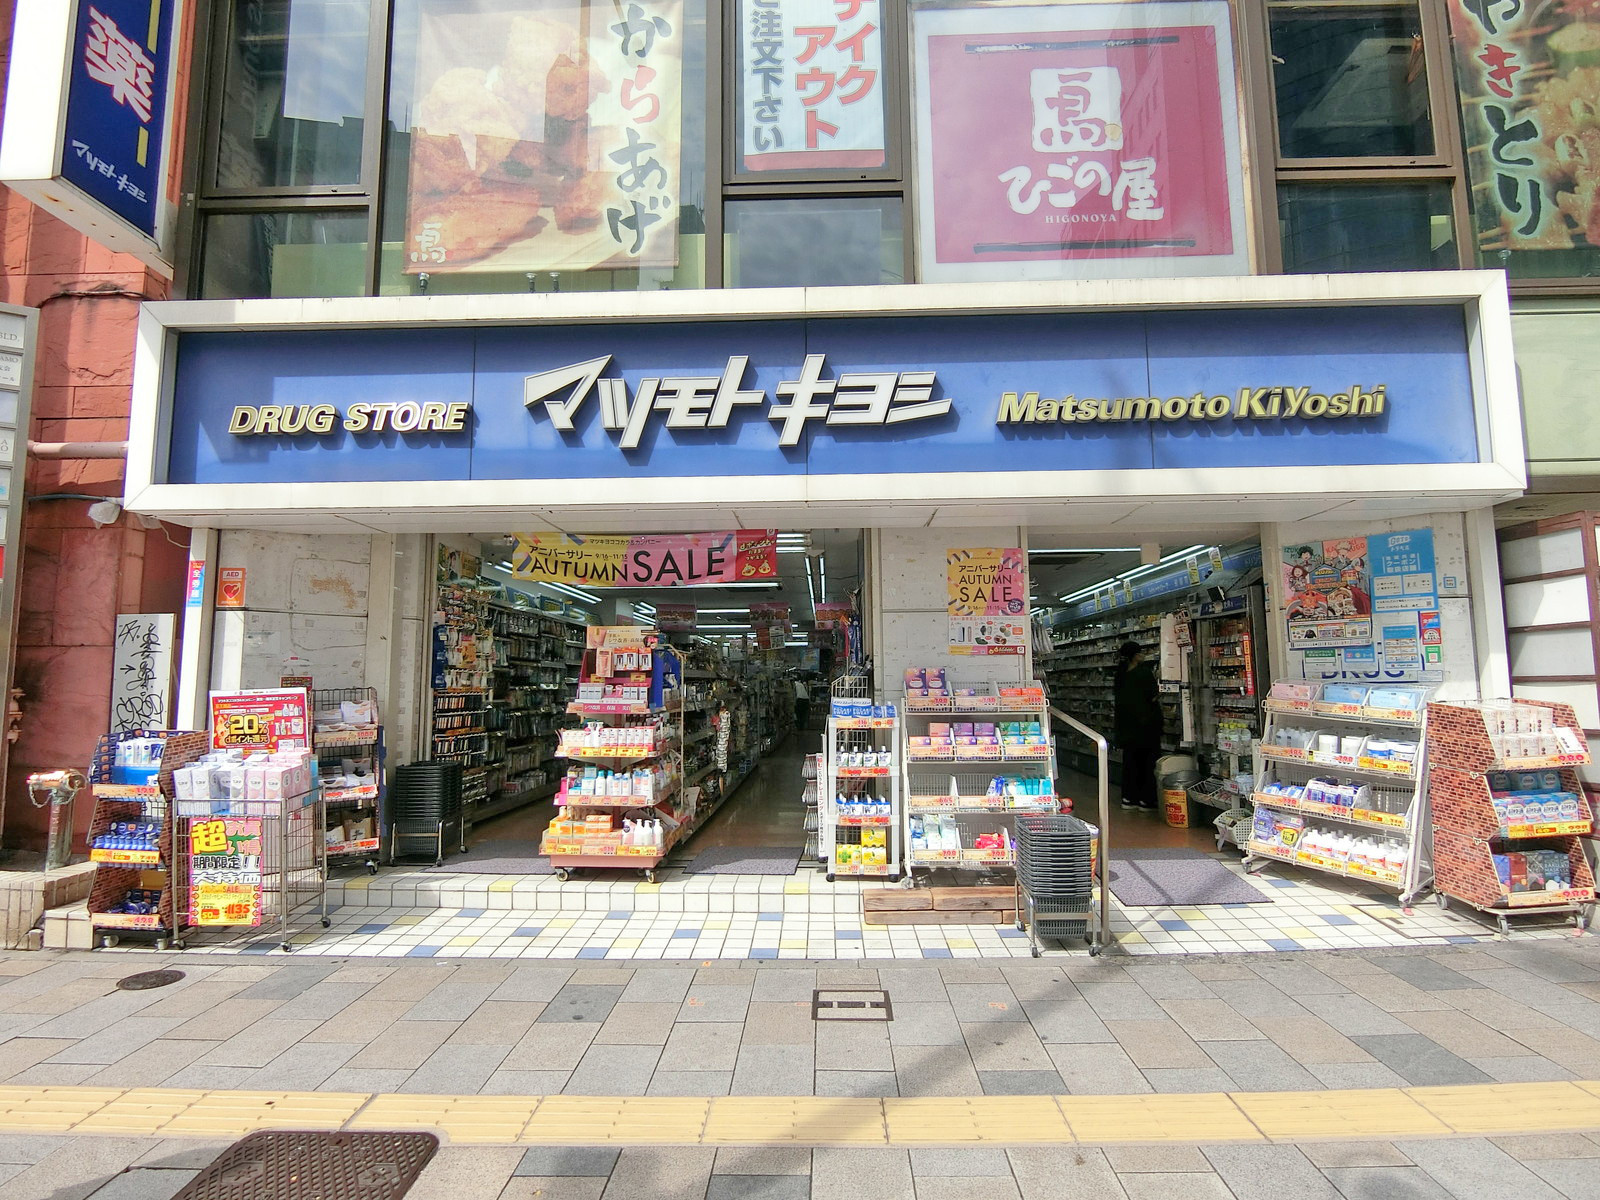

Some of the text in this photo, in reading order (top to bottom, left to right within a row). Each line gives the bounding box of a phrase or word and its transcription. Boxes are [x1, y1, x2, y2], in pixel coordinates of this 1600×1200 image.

[84, 5, 155, 123] 薬
[606, 2, 673, 255] からあげ
[71, 139, 148, 204] マツモトキヨシ
[997, 155, 1165, 221] ひごの屋
[1045, 213, 1117, 224] HIGONOYA
[228, 400, 471, 435] DRUG STORE
[523, 353, 953, 450] マツモトキヨシ
[996, 383, 1388, 425] Matsumoto KiYoshi
[528, 545, 593, 560] アニバーサリー
[530, 546, 725, 584] AUTUMN SALE
[958, 564, 1012, 573] アニバーサリー
[1386, 559, 1417, 567] クーポン
[959, 574, 1012, 585] AUTUMN
[960, 587, 1012, 602] SALE
[191, 820, 228, 855] 超
[191, 871, 261, 885] 大特価
